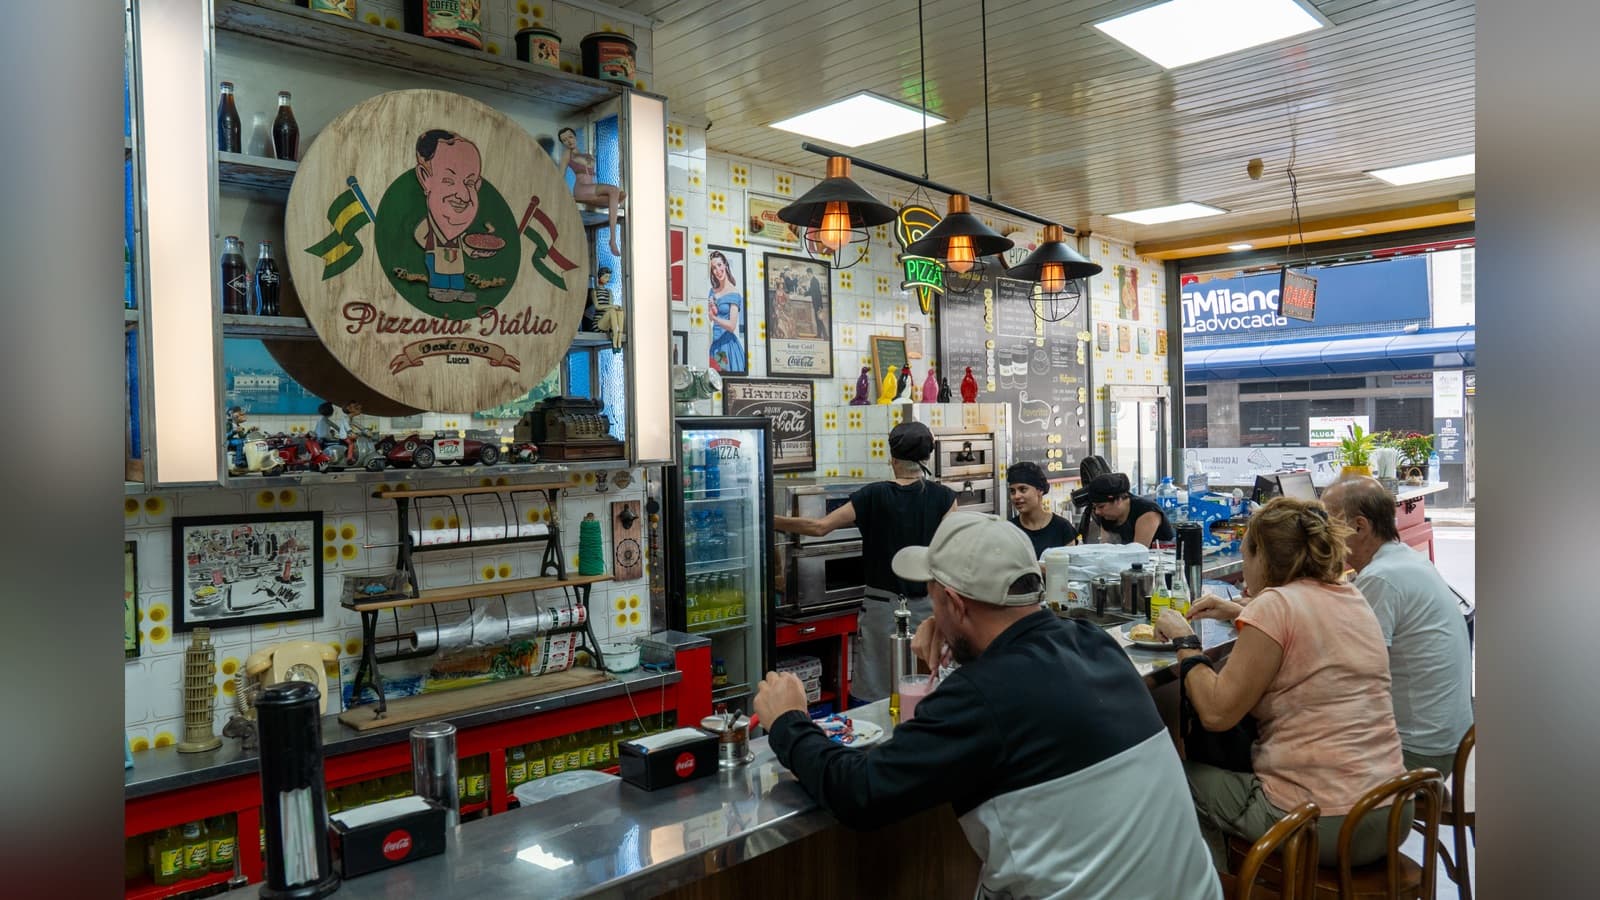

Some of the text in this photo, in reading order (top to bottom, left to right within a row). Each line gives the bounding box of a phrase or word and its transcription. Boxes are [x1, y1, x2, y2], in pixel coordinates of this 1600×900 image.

[906, 259, 943, 288] PIZZA
[1284, 285, 1315, 310] CAIXA
[342, 301, 558, 337] Pizzaria Itália
[446, 354, 470, 365] Lucca
[742, 387, 809, 400] HAMMER'S
[711, 446, 740, 460] PIZZA
